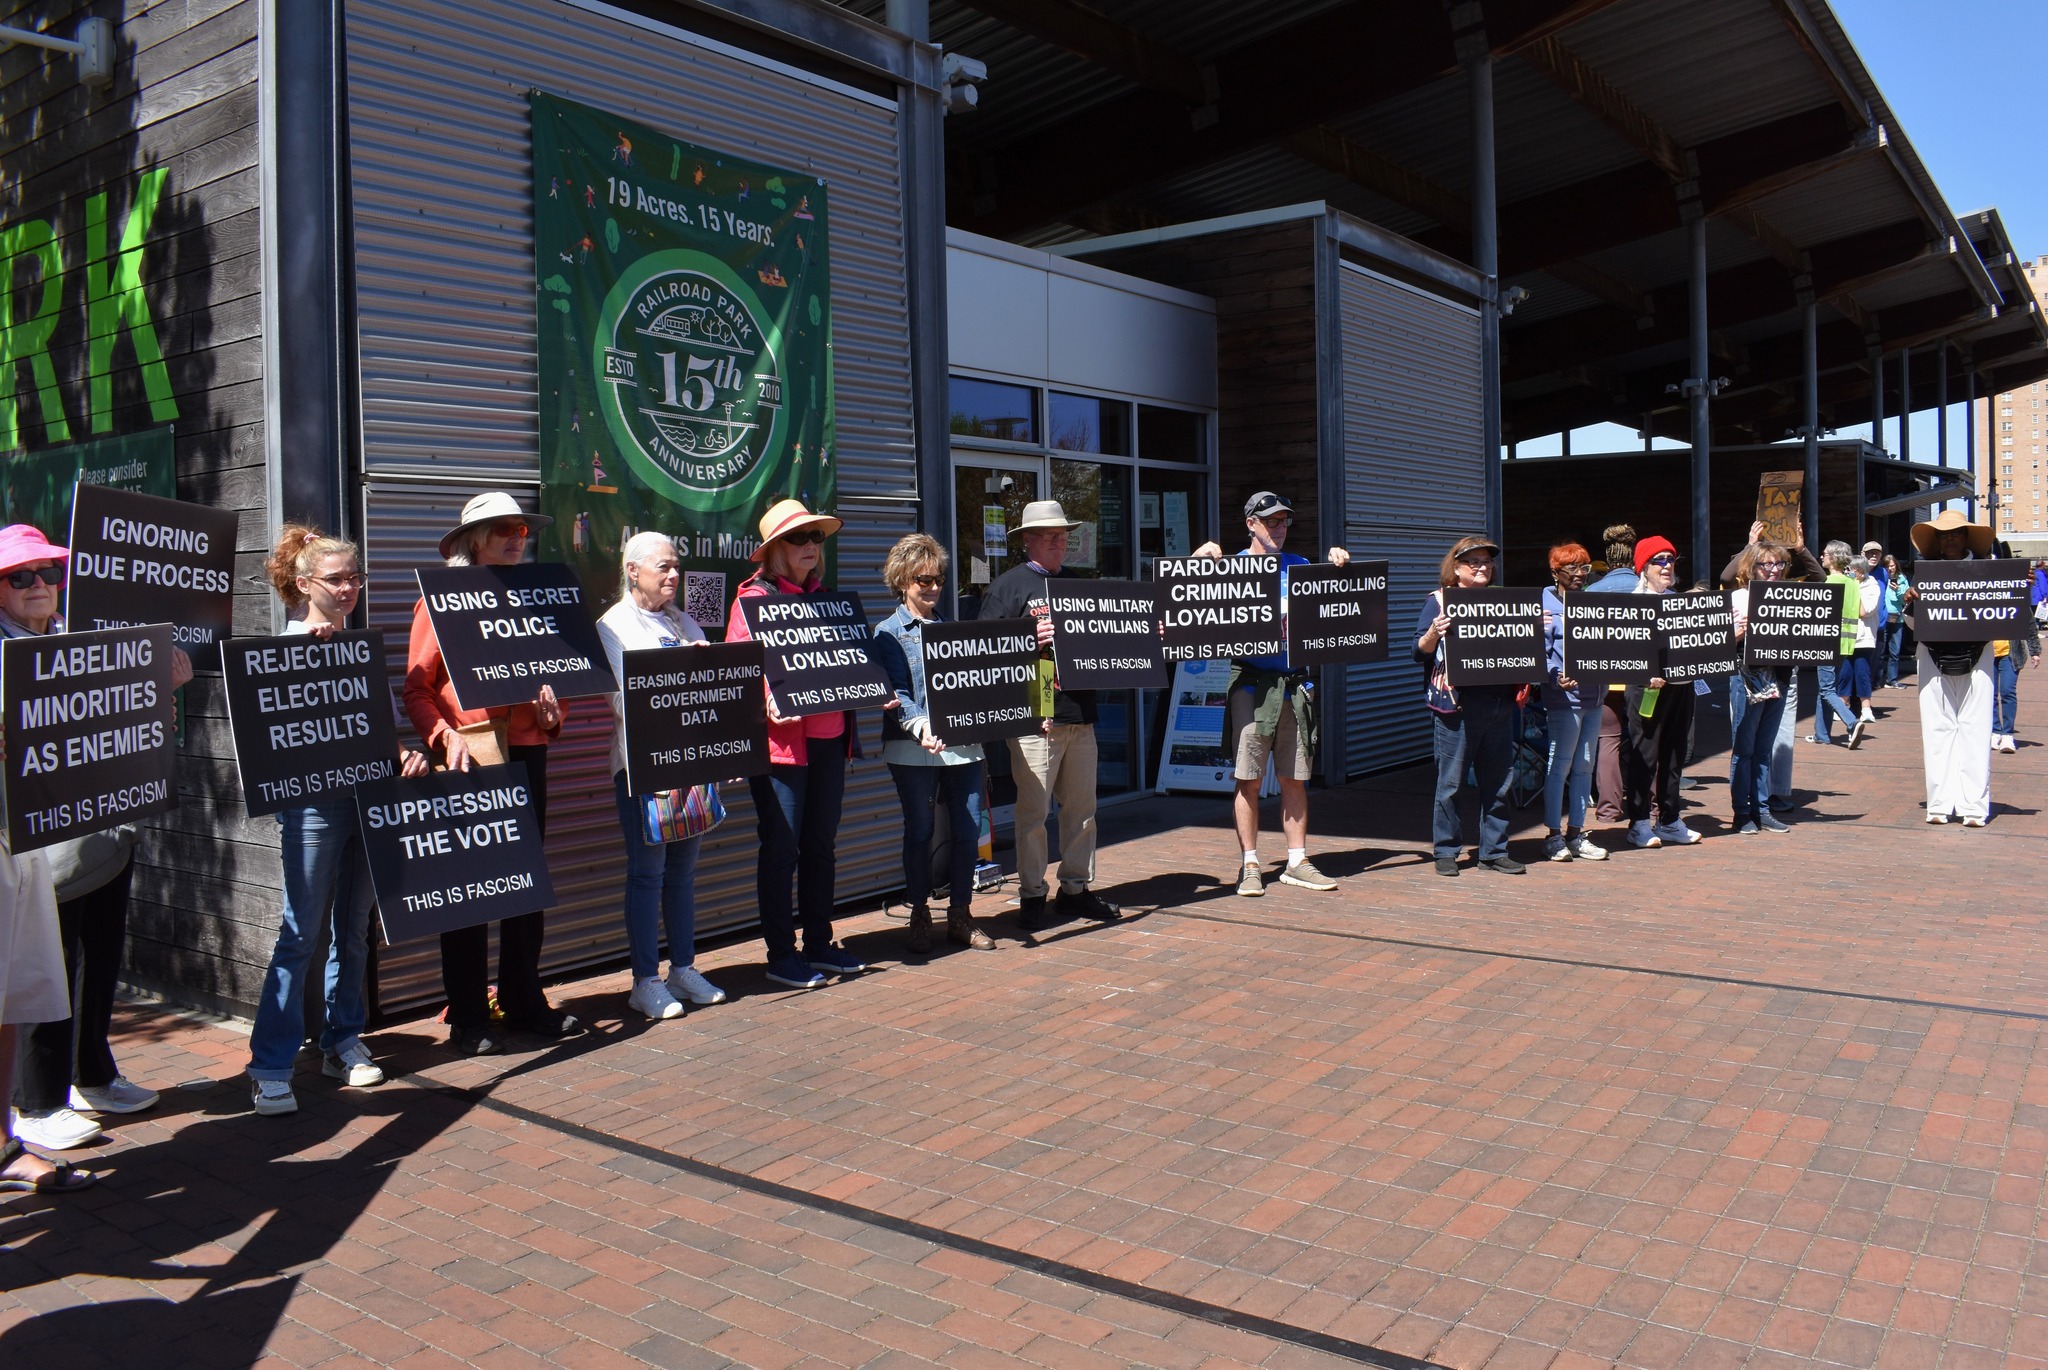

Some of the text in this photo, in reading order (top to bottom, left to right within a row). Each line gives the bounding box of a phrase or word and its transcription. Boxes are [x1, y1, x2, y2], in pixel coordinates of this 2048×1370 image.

[607, 176, 775, 248] 19 Acres. 15 Years.
[637, 281, 753, 339] RAILROAD PARK
[606, 355, 634, 378] ESTD
[655, 351, 744, 412] 15th
[758, 382, 780, 401] 2010
[649, 437, 753, 480] ANNIVERSARY
[79, 459, 148, 485] Please consider
[102, 516, 209, 555] IGNORING
[696, 531, 713, 558] in
[76, 551, 230, 593] DUE PROCESS
[1159, 556, 1278, 577] PARDONING
[1171, 582, 1267, 602] CRIMINAL
[1291, 576, 1386, 596] CONTROLLING
[1764, 587, 1833, 601] ACCUSING
[1918, 580, 2027, 590] OUR GRANDPARENTS
[430, 587, 581, 613] USING SECRET
[1052, 598, 1096, 614] USING
[1099, 598, 1154, 614] MILITARY
[1662, 595, 1724, 612] REPLACING
[1920, 593, 1963, 601] FOUGHT
[758, 600, 854, 622] APPOINTING
[1165, 605, 1273, 627] LOYALISTS
[1319, 602, 1361, 618] MEDIA
[1447, 603, 1542, 618] CONTROLLING
[1567, 606, 1656, 621] USING FEAR TO
[1757, 604, 1832, 619] OTHERS OF
[1927, 607, 2017, 621] WILL YOU?
[479, 616, 559, 640] POLICE
[1064, 619, 1150, 634] ON CIVILIANS
[1458, 624, 1534, 638] EDUCATION
[1657, 612, 1733, 631] SCIENCE WITH
[1750, 622, 1839, 637] YOUR CRIMES
[173, 625, 213, 644] SCISM
[1303, 633, 1377, 650] THIS IS FASCISM
[1572, 627, 1651, 640] GAIN POWER
[1669, 631, 1728, 650] IDEOLOGY
[245, 639, 371, 675] REJECTING
[926, 634, 1036, 660] NORMALIZING
[1162, 645, 1194, 659] THIS
[1199, 644, 1212, 658] IS
[1216, 641, 1279, 657] FASCISM
[1753, 649, 1834, 660] THIS IS FASCISM
[36, 639, 153, 681] LABELING
[472, 656, 592, 683] THIS IS FASCISM
[782, 648, 868, 672] LOYALISTS
[1073, 658, 1152, 670] THIS IS FASCISM
[1461, 657, 1536, 669] THIS IS FASCISM
[1576, 659, 1648, 670] THIS IS FASCISM
[1663, 660, 1735, 679] THIS IS FASCISM
[628, 665, 761, 690] ERASING AND FAKING
[932, 664, 1036, 691] CORRUPTION
[22, 680, 157, 730] MINORITIES
[258, 676, 369, 713] ELECTION
[650, 686, 744, 710] GOVERNMENT
[788, 682, 887, 707] THIS IS FASCISM
[681, 709, 718, 726] DATA
[947, 706, 1032, 728] THIS IS FASCISM
[269, 711, 370, 750] RESULTS
[22, 721, 164, 777] AS ENEMIES
[650, 739, 751, 766] THIS IS FASCISM
[258, 759, 394, 802] THIS IS FASCISM
[25, 778, 168, 835] THIS IS FASCISM
[367, 785, 529, 829] SUPPRESSING
[399, 819, 521, 860] THE VOTE
[402, 872, 534, 913] THIS IS FASCISM
